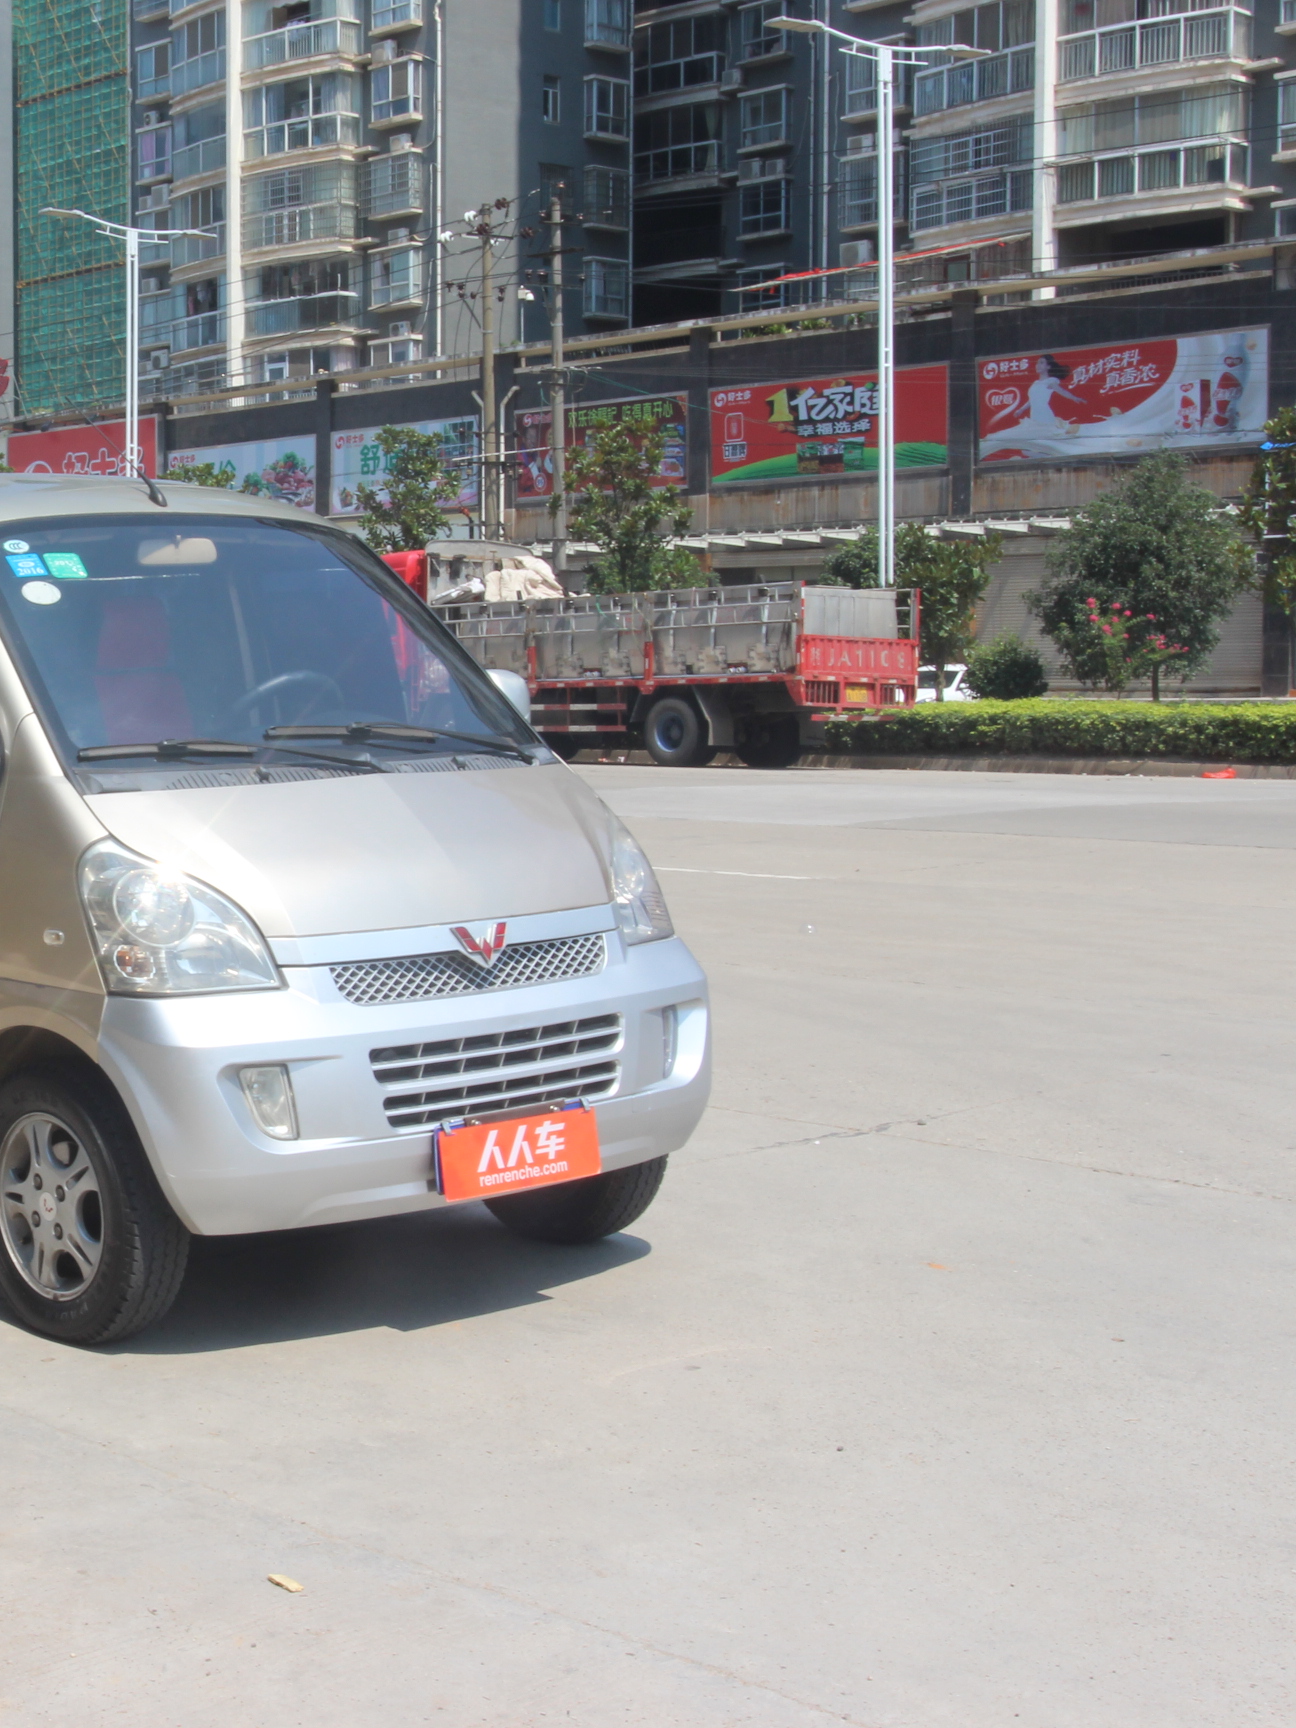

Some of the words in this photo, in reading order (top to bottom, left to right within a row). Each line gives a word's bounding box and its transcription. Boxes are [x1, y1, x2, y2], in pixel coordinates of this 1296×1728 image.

[999, 359, 1029, 372] 好士多
[1068, 349, 1141, 389] 真材实料
[1100, 363, 1160, 393] 真香浓
[727, 390, 751, 402] 好士多
[765, 386, 881, 423] 1亿家庭
[797, 419, 871, 437] 幸福选择
[17, 567, 44, 576] 2016
[477, 1120, 566, 1174] 人人车
[479, 1161, 569, 1187] renrenche.com
